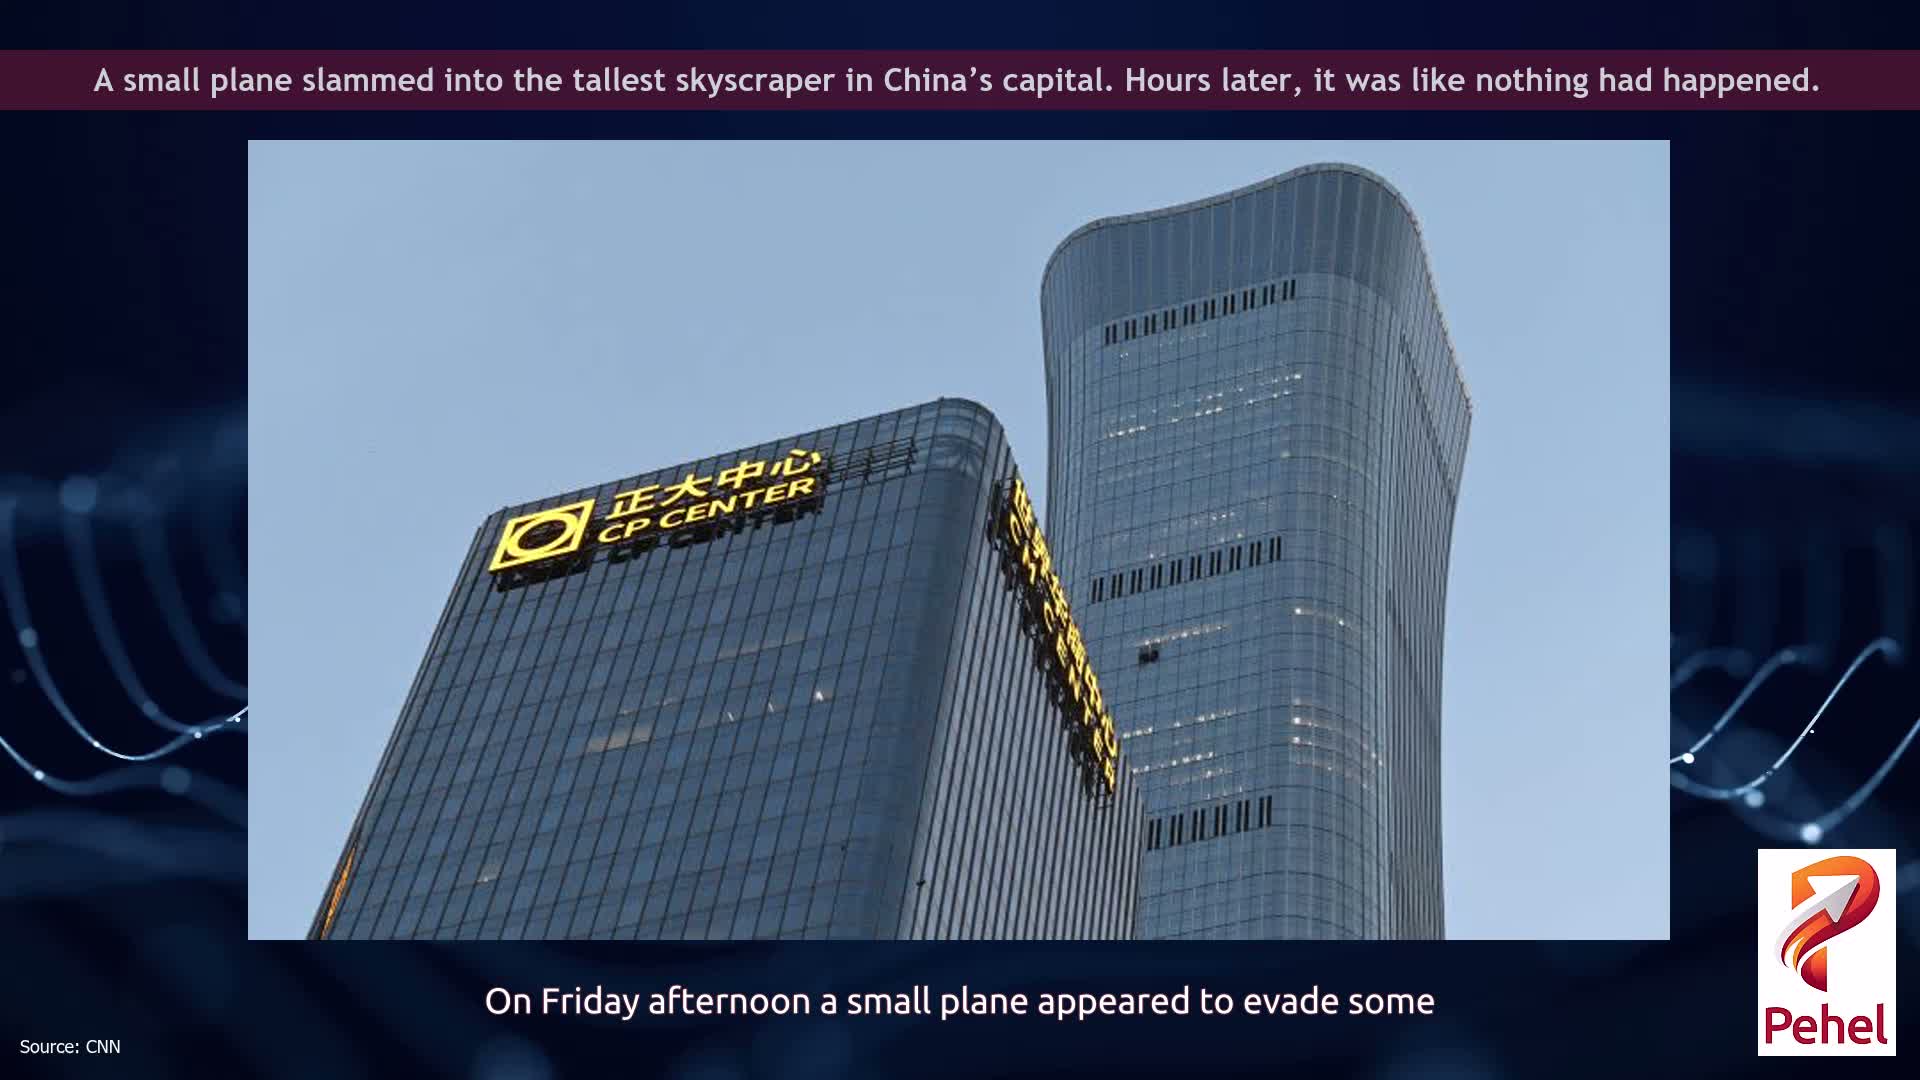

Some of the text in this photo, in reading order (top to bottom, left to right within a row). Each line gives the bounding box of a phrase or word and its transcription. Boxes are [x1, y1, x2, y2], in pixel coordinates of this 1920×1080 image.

[597, 477, 815, 543] CP CENTER
[605, 449, 821, 520] 正大中心
